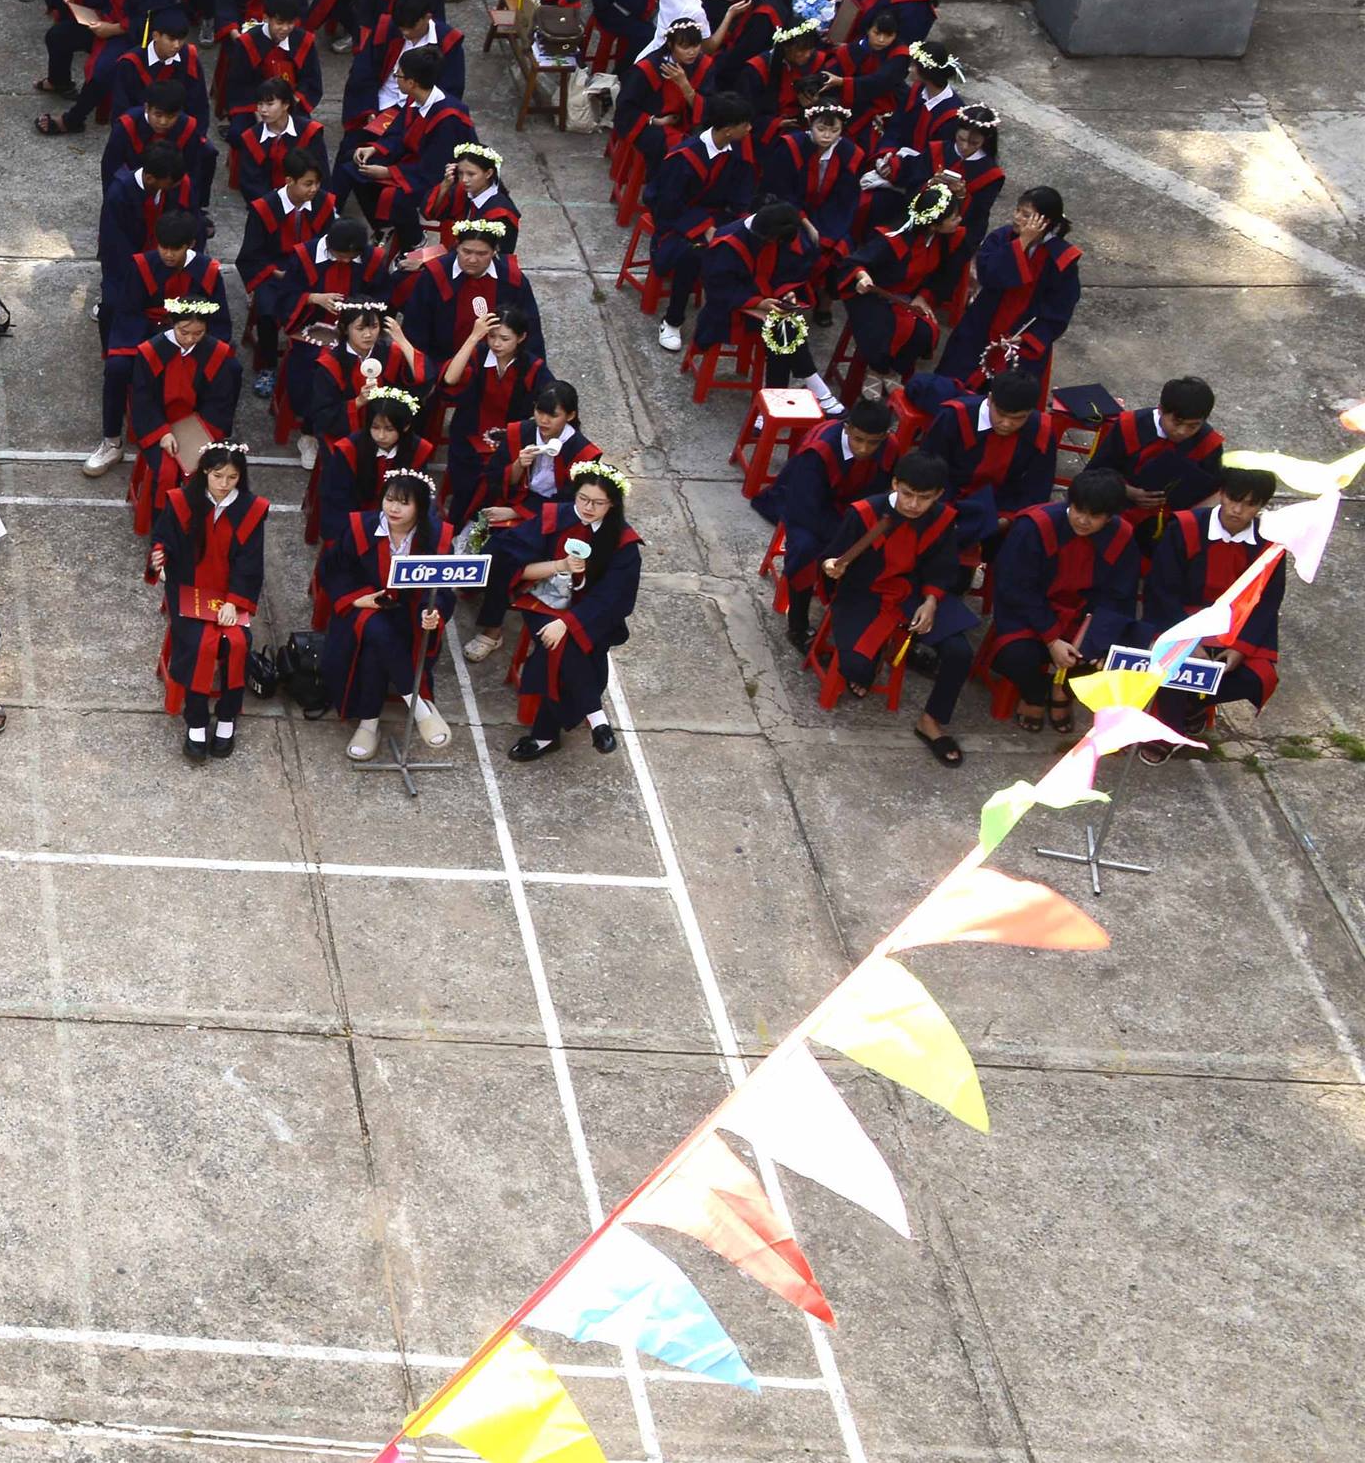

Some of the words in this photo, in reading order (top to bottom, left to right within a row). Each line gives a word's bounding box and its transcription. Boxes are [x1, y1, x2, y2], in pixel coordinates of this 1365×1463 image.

[400, 564, 437, 582] LỚP
[441, 566, 478, 581] 9A2
[1171, 668, 1206, 686] A1
